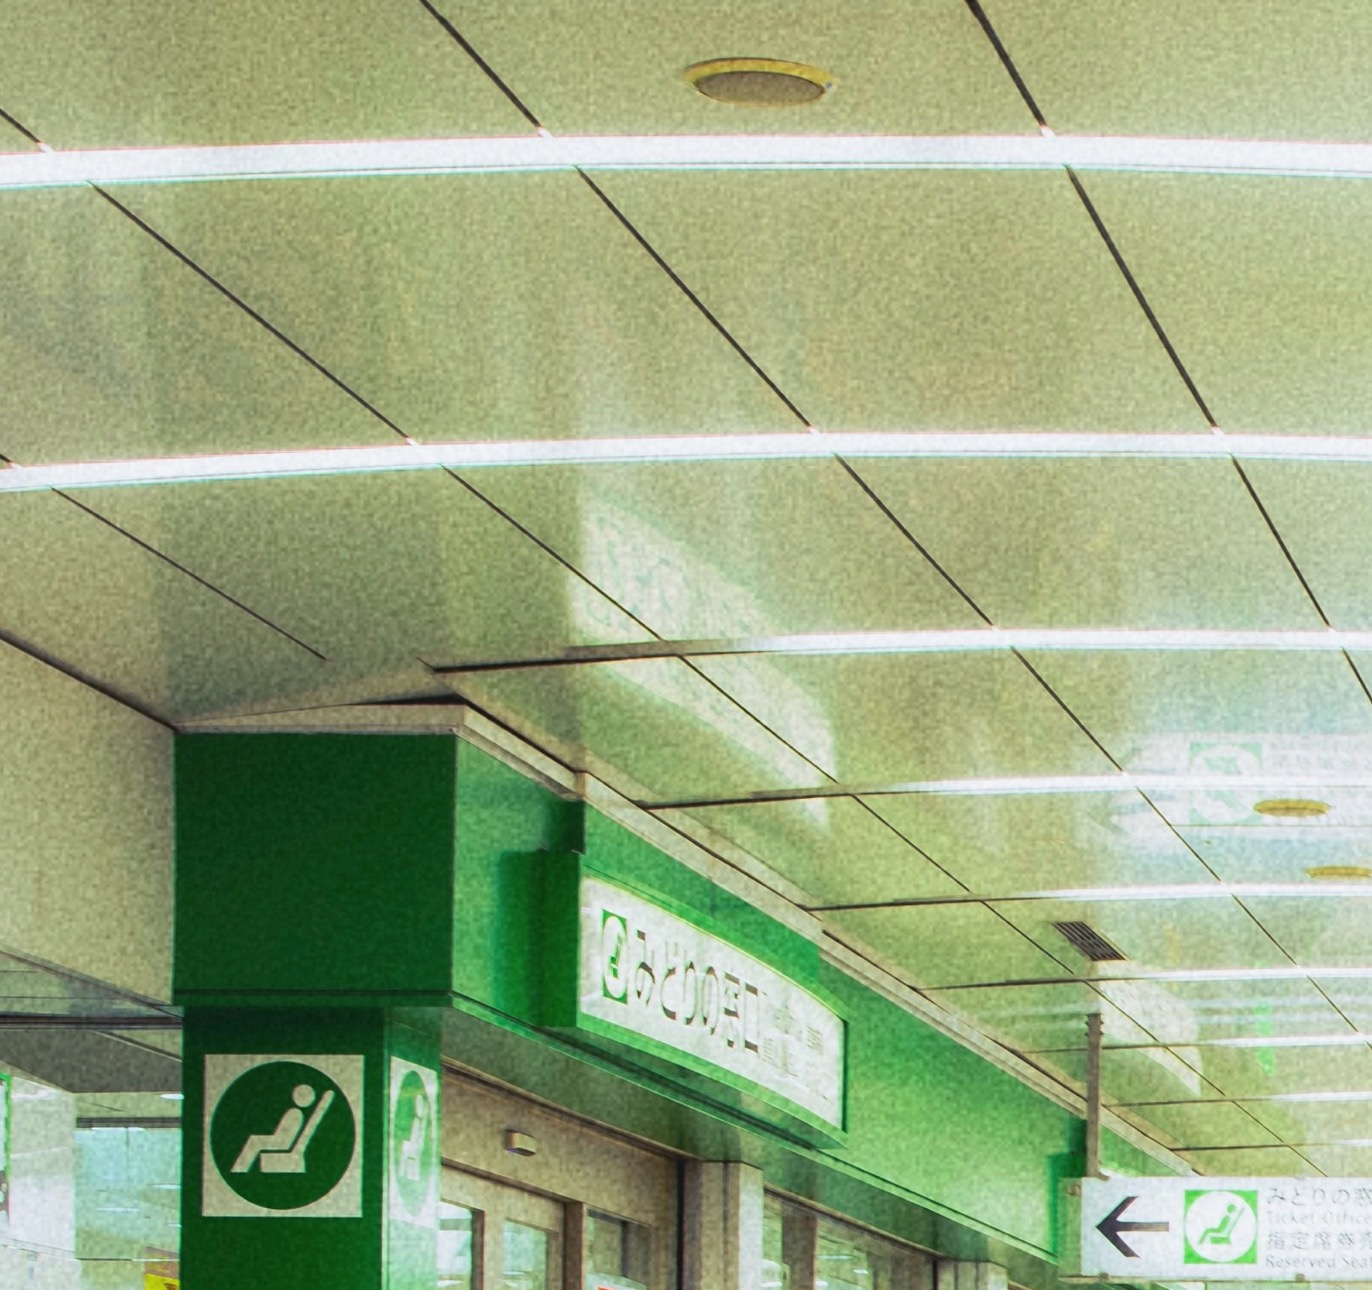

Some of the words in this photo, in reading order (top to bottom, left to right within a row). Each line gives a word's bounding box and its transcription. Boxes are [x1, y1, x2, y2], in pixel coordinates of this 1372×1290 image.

[635, 929, 760, 1054] みどりの窓口
